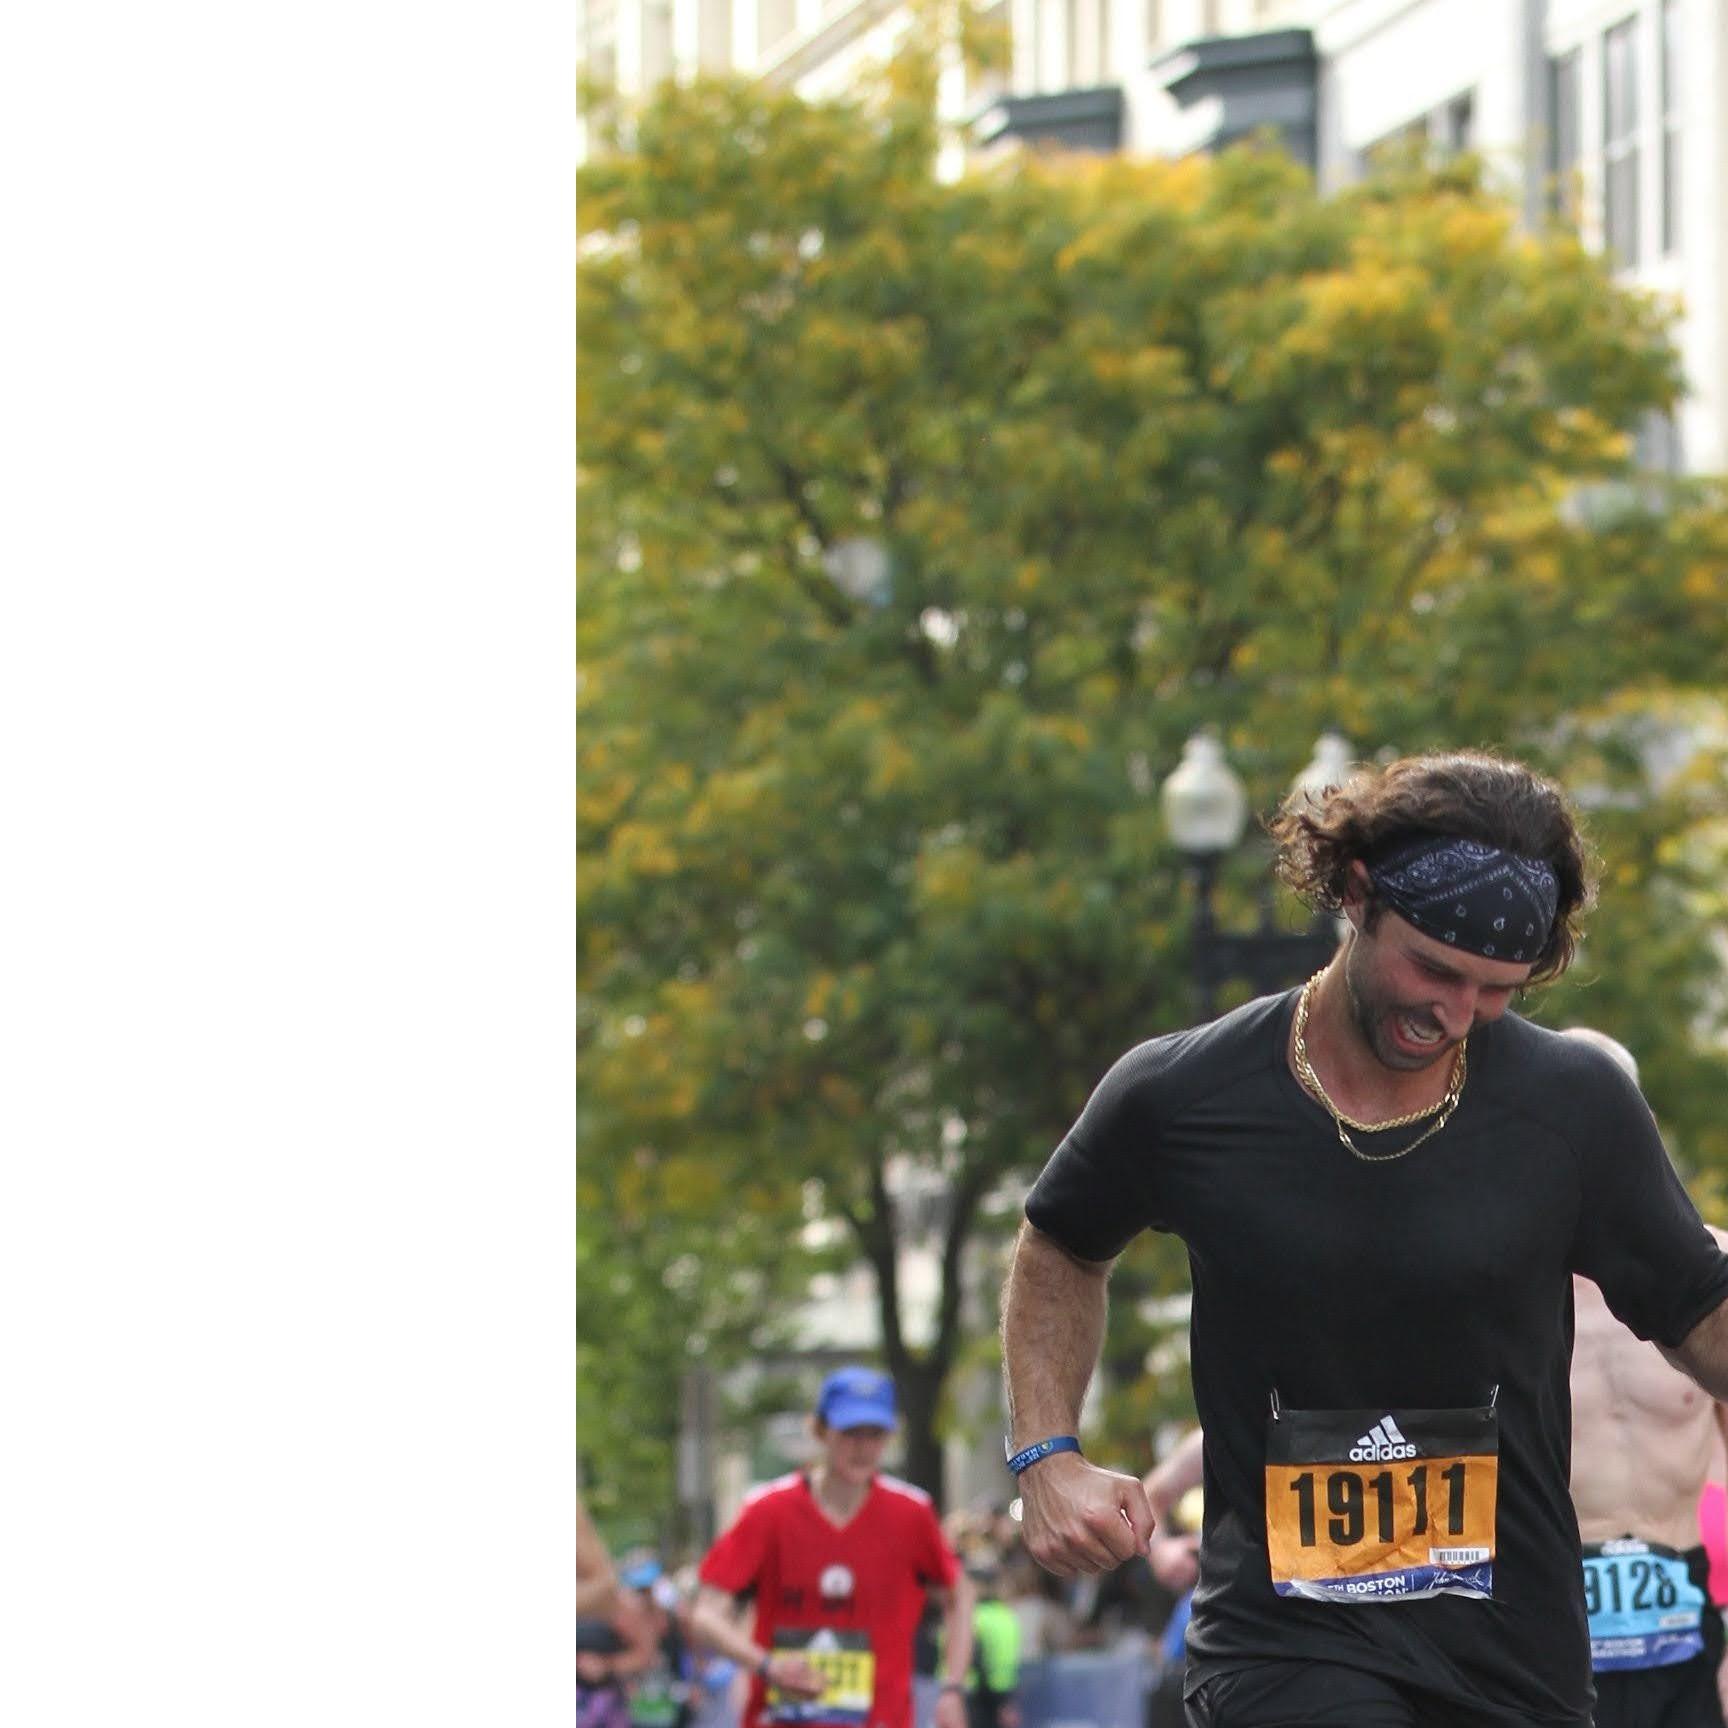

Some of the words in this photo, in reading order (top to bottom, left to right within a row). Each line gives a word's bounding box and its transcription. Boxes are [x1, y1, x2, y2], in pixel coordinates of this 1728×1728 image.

[1349, 1442, 1417, 1462] adidas
[1289, 1462, 1466, 1548] 19111
[1346, 1575, 1406, 1594] BOSTON
